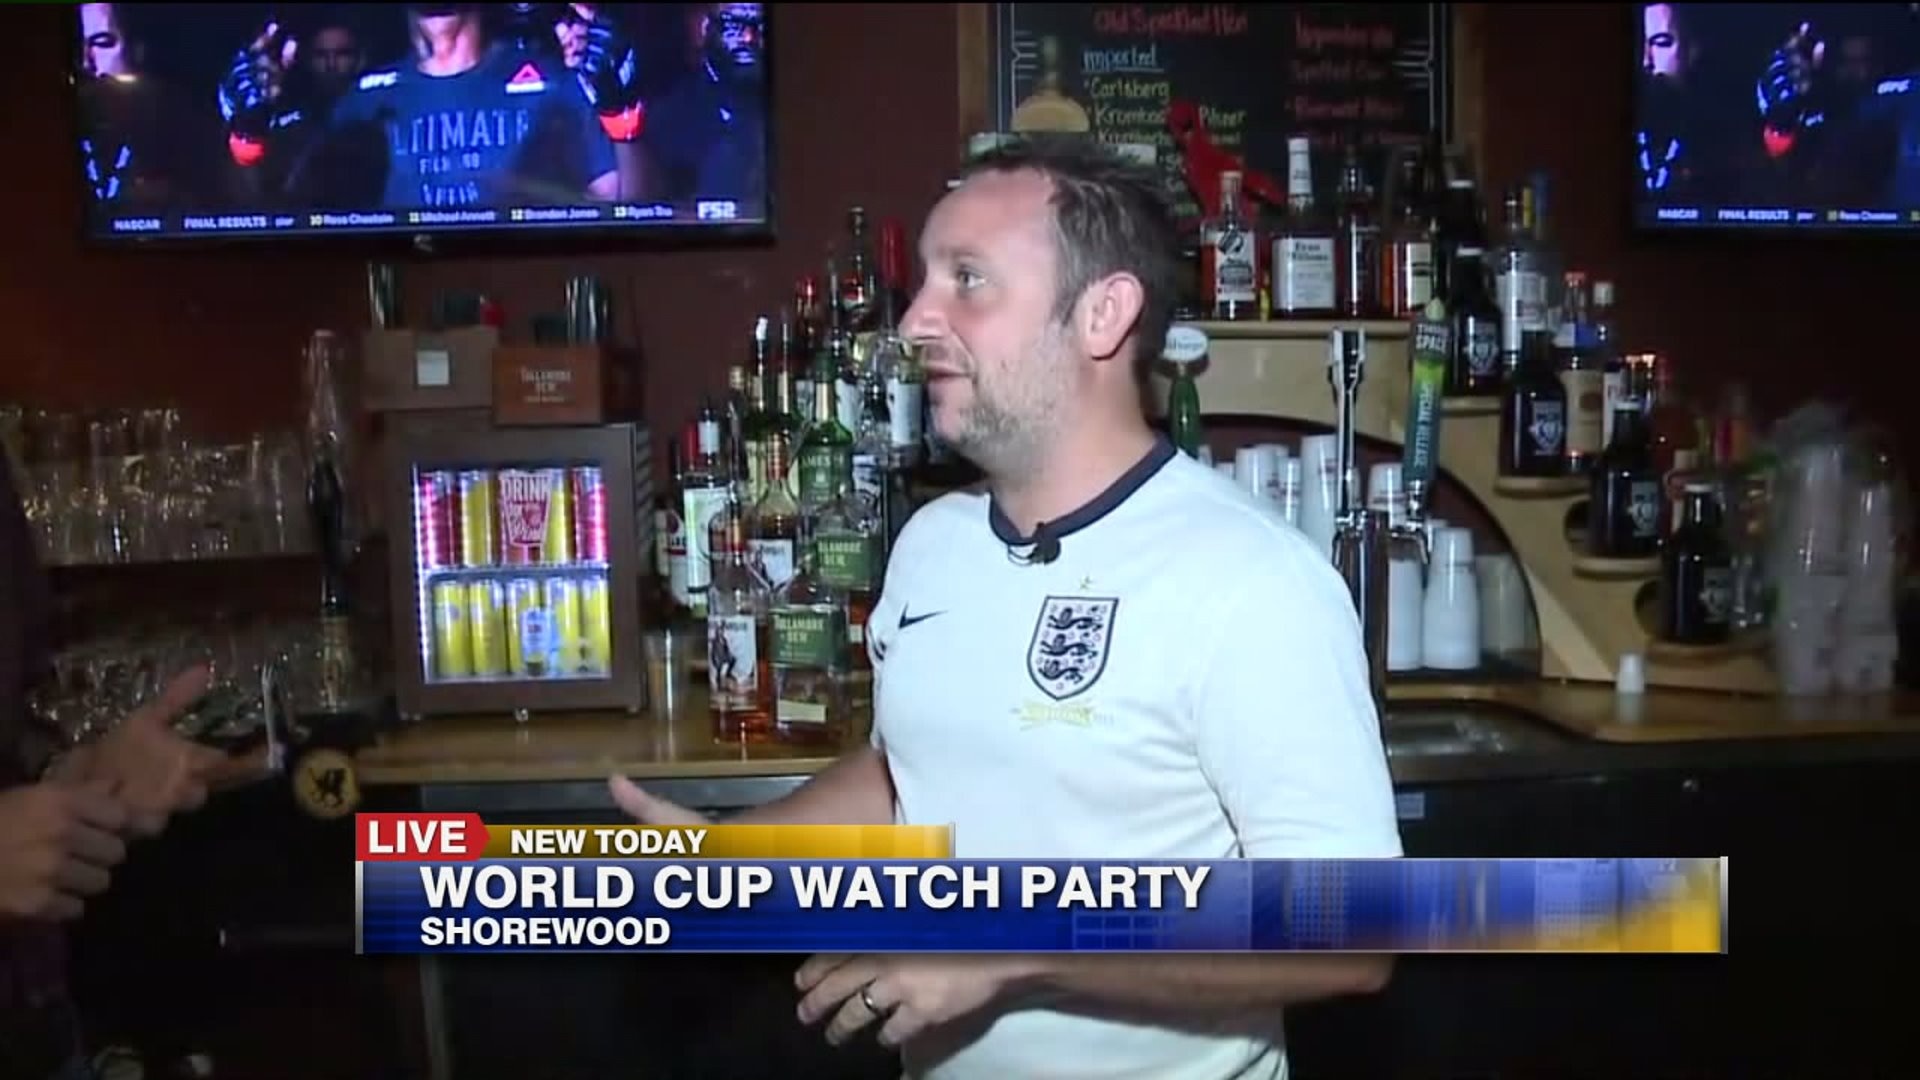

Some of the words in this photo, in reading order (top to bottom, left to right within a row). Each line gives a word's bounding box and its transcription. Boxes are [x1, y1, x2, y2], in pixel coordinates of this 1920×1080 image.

[391, 109, 529, 156] LTIMATE
[511, 209, 523, 220] 12
[614, 207, 627, 217] 13
[698, 201, 735, 219] FS2
[114, 219, 161, 231] NASCAR
[184, 217, 216, 230] FINAL
[217, 216, 267, 229] RESULTS
[310, 214, 323, 226] 10
[502, 475, 552, 501] DRINK
